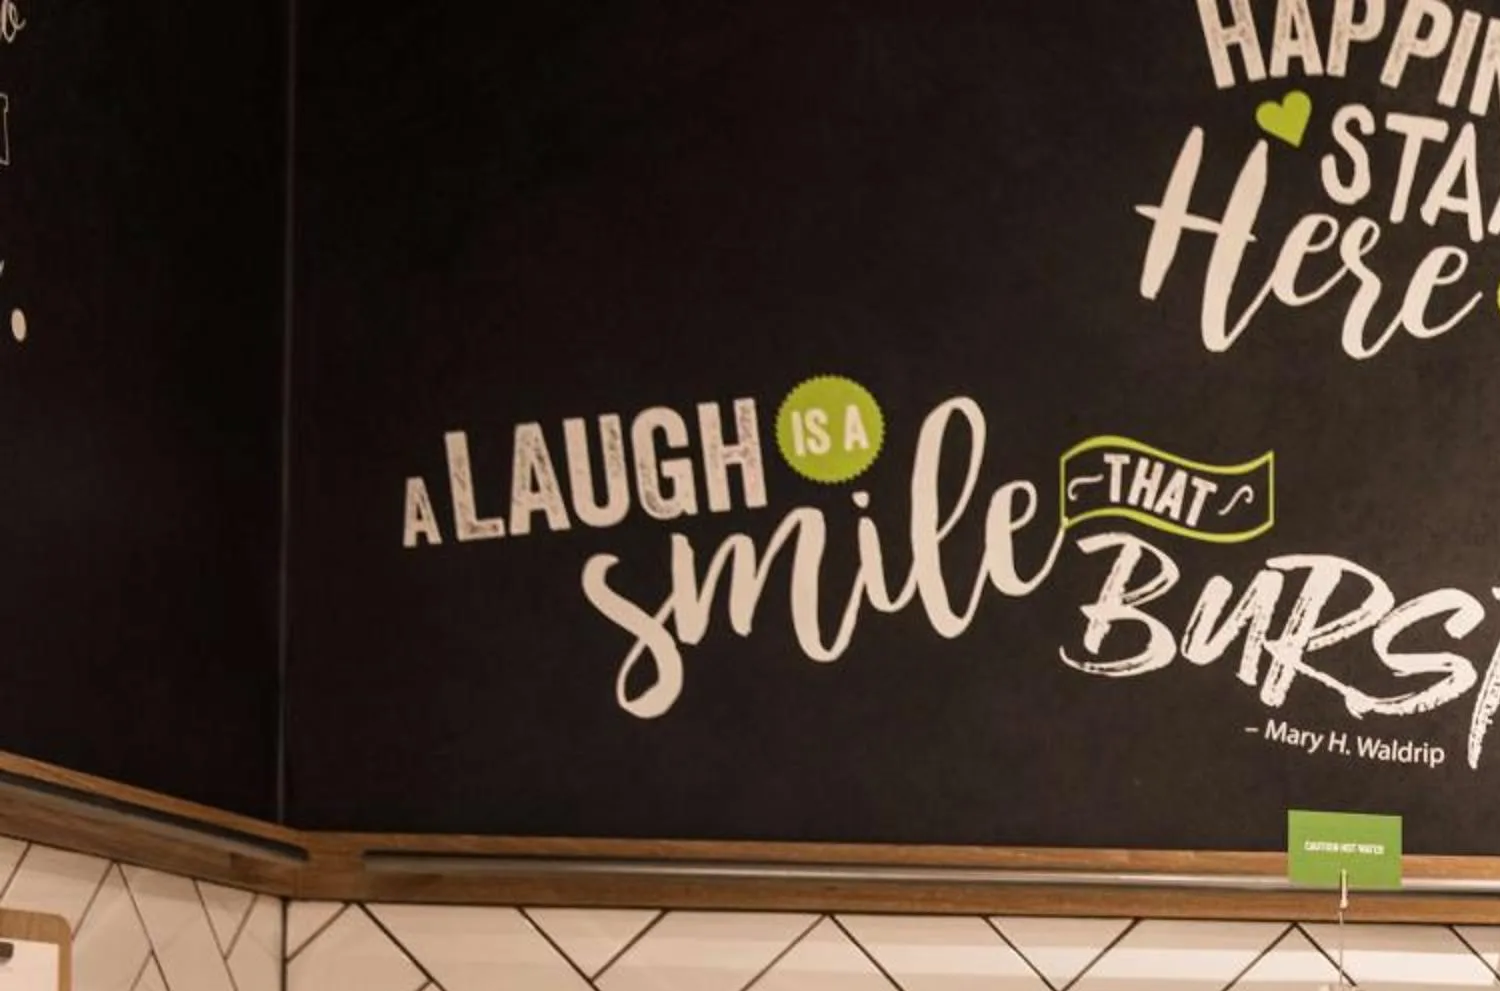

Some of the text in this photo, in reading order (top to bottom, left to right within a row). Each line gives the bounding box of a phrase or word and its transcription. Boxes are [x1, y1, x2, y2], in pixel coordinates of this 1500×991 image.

[1135, 126, 1483, 361] Here
[403, 397, 768, 547] A LAUGH
[791, 403, 870, 456] IS A
[1103, 452, 1218, 527] THAT
[581, 396, 1067, 719] smile
[1264, 719, 1324, 754] Mary
[1327, 731, 1351, 755] H.
[1356, 735, 1446, 769] Waldrip
